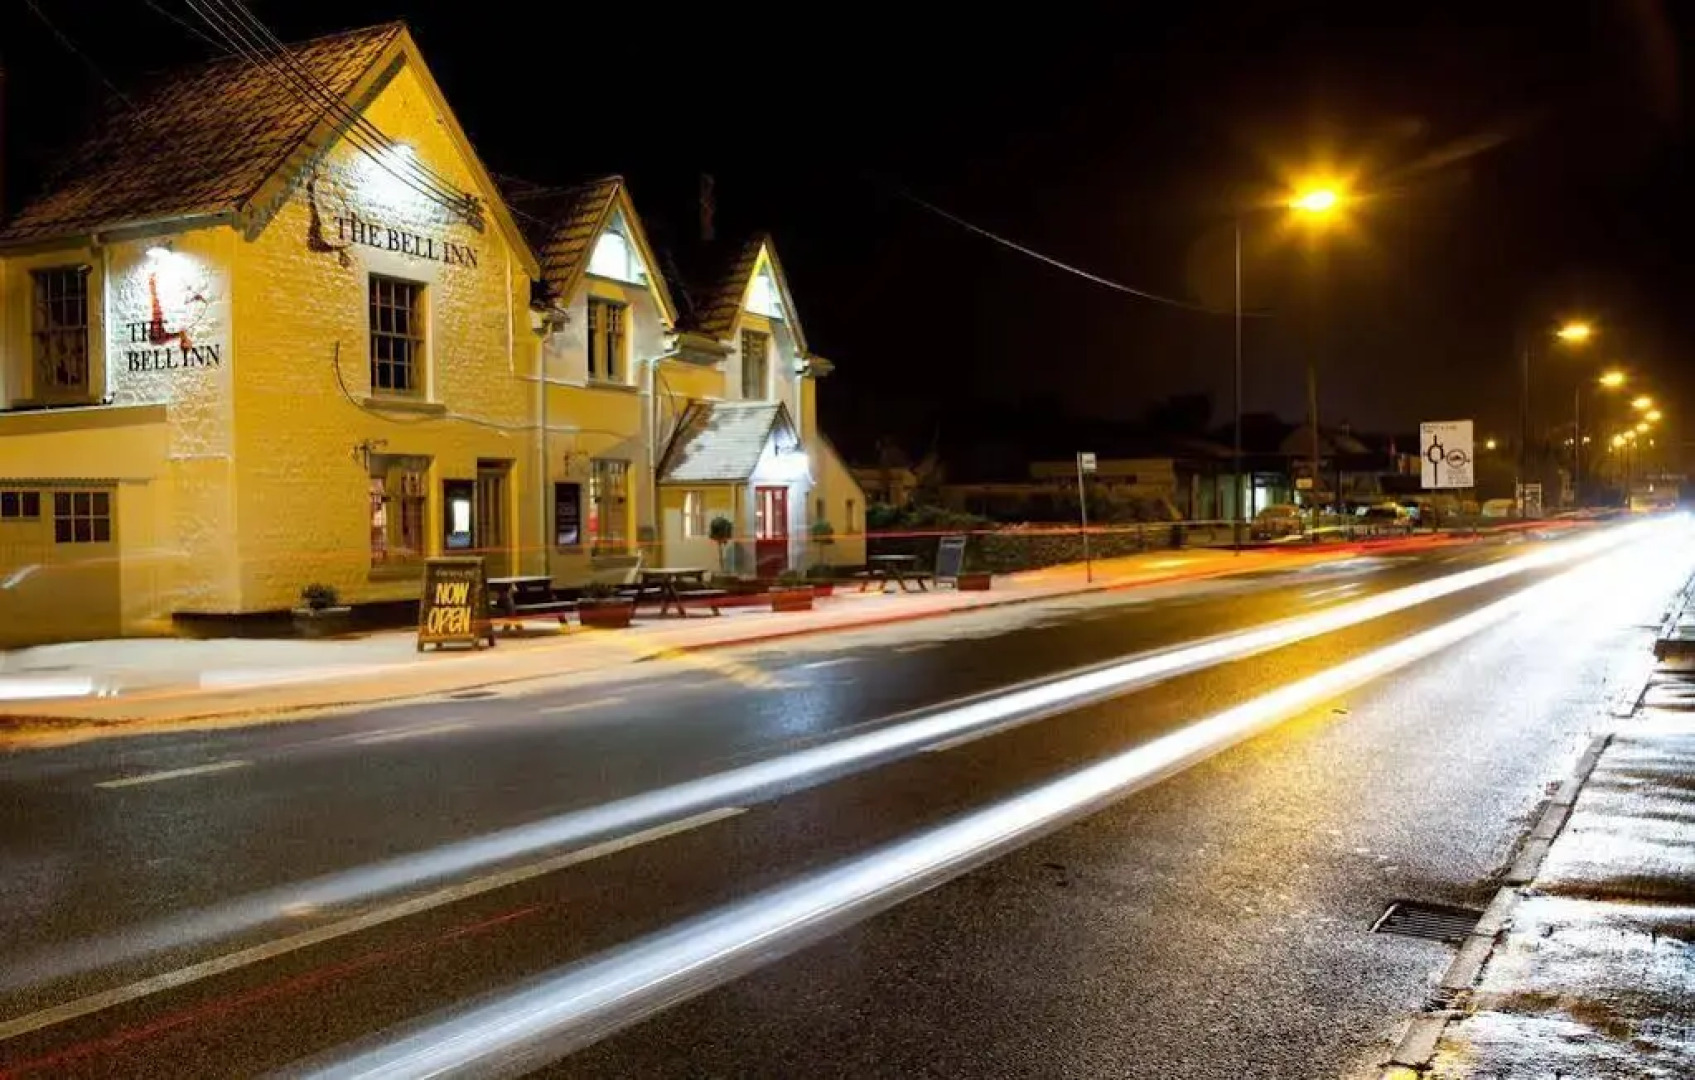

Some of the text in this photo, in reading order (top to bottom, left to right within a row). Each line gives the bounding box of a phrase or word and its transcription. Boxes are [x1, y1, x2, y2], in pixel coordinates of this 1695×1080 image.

[334, 211, 479, 267] THE BELL INN
[127, 344, 220, 371] BELL INN
[434, 581, 470, 605] NOW
[428, 606, 471, 634] OPEN
